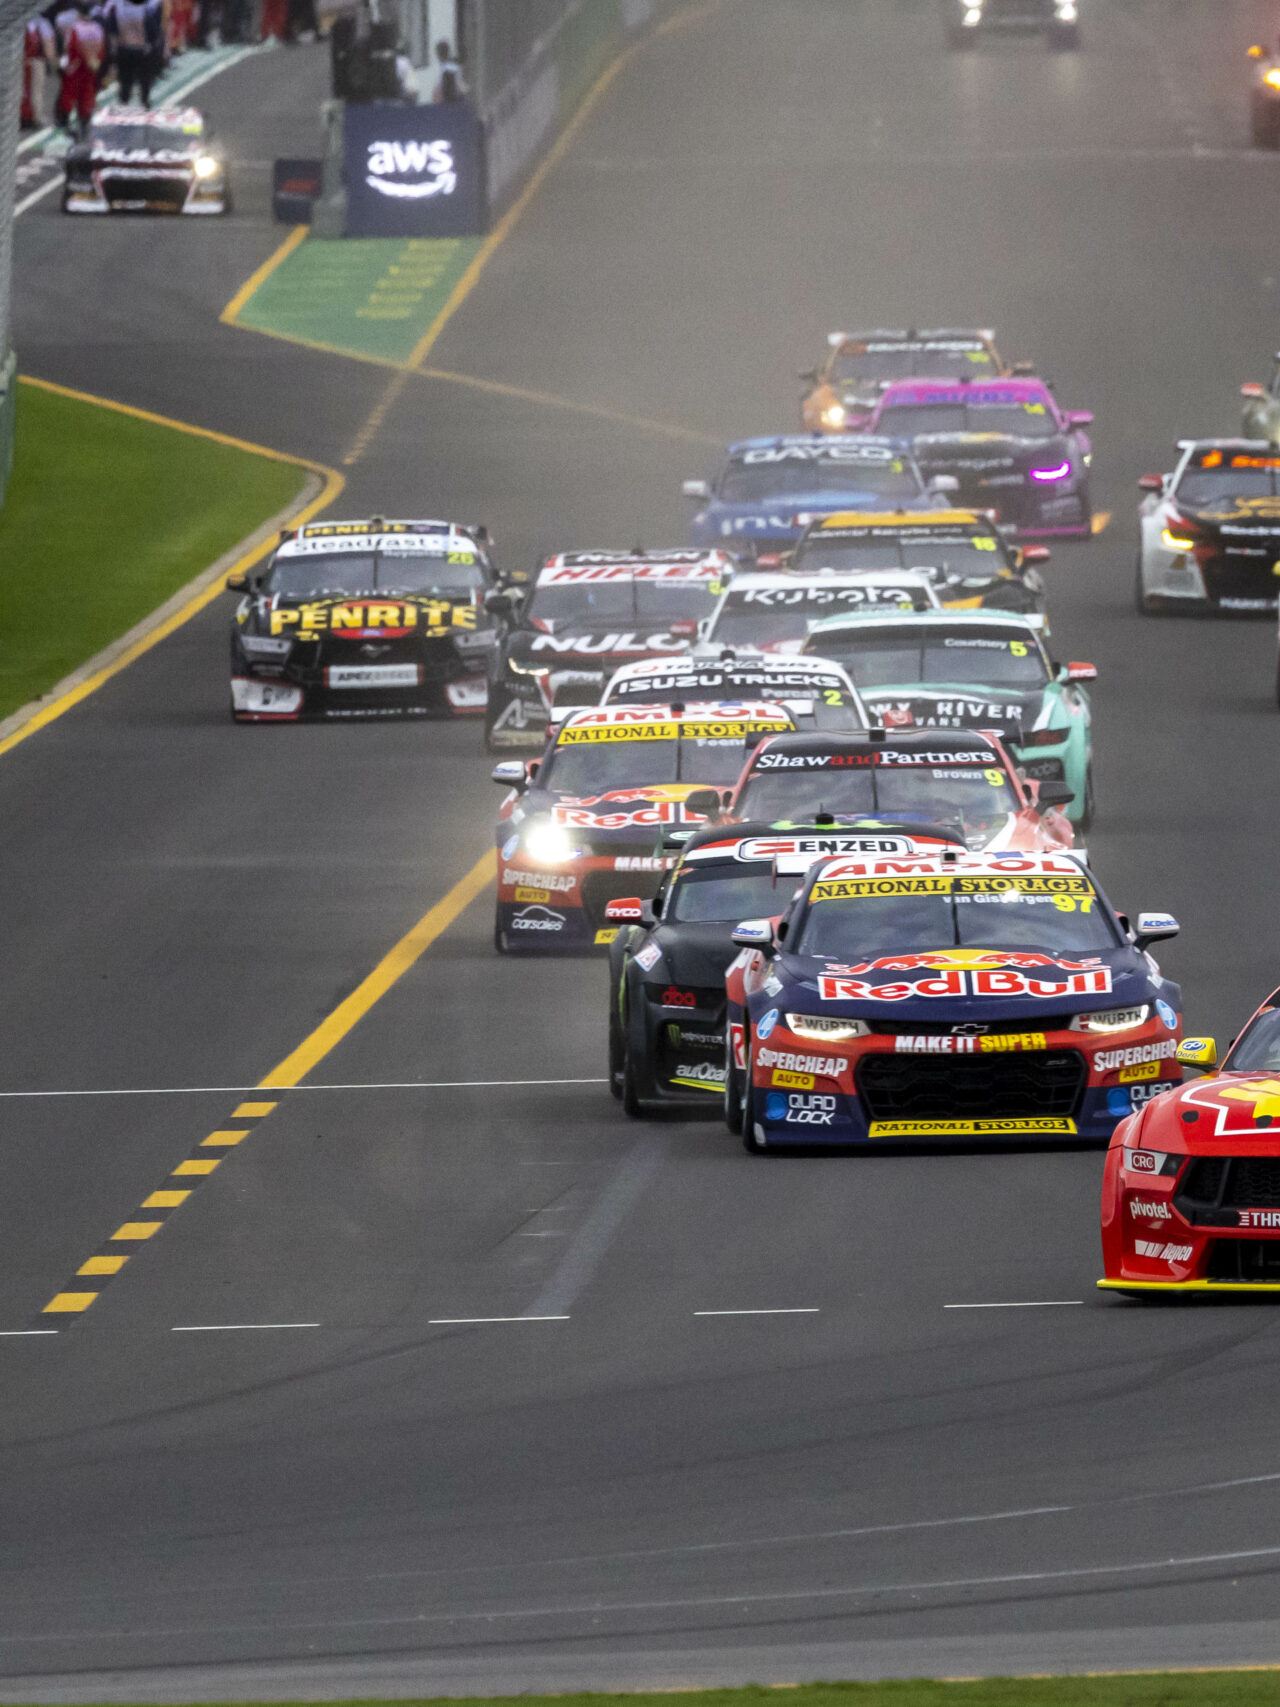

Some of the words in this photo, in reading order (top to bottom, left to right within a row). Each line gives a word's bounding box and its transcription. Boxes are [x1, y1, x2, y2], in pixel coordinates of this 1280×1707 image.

[367, 139, 453, 175] aws
[744, 446, 893, 464] DAYCO
[294, 537, 427, 552] Steadfast
[447, 552, 475, 566] 26
[743, 586, 912, 605] Kubota
[270, 605, 477, 635] PENRITE
[944, 637, 1008, 650] Courtney
[1009, 640, 1028, 658] 5
[618, 674, 723, 694] ISUZU
[726, 674, 842, 688] TRUCKS
[823, 690, 844, 707] 2
[936, 701, 1023, 720] RIVER
[564, 726, 671, 743] NATIONAL
[932, 768, 982, 780] Brown
[984, 769, 1005, 787] 9
[553, 802, 672, 829] Red
[799, 841, 898, 853] ENZED
[614, 856, 662, 871] MAKE
[816, 879, 946, 898] NATIONAL
[961, 878, 1089, 894] STORAGE
[606, 907, 642, 917] RYCO
[1053, 894, 1095, 913] 97
[512, 918, 563, 931] carsales
[819, 970, 966, 1001] Red
[974, 968, 1113, 998] Bull
[895, 1036, 951, 1053] MAKE
[954, 1036, 976, 1053] IT
[980, 1032, 1047, 1053] SUPER
[756, 1047, 848, 1078] SUPERCHEAP
[1093, 1038, 1178, 1073] SUPERCHEAP
[1176, 1051, 1199, 1060] Doric
[775, 1073, 811, 1086] AUTO
[1123, 1065, 1156, 1080] AUTO
[788, 1094, 836, 1111] QUAD
[785, 1109, 835, 1126] LOCK
[874, 1120, 970, 1133] NATIONAL
[977, 1118, 1069, 1132] STORAGE
[1132, 1155, 1154, 1169] CRC
[1129, 1197, 1172, 1219] pivotel.
